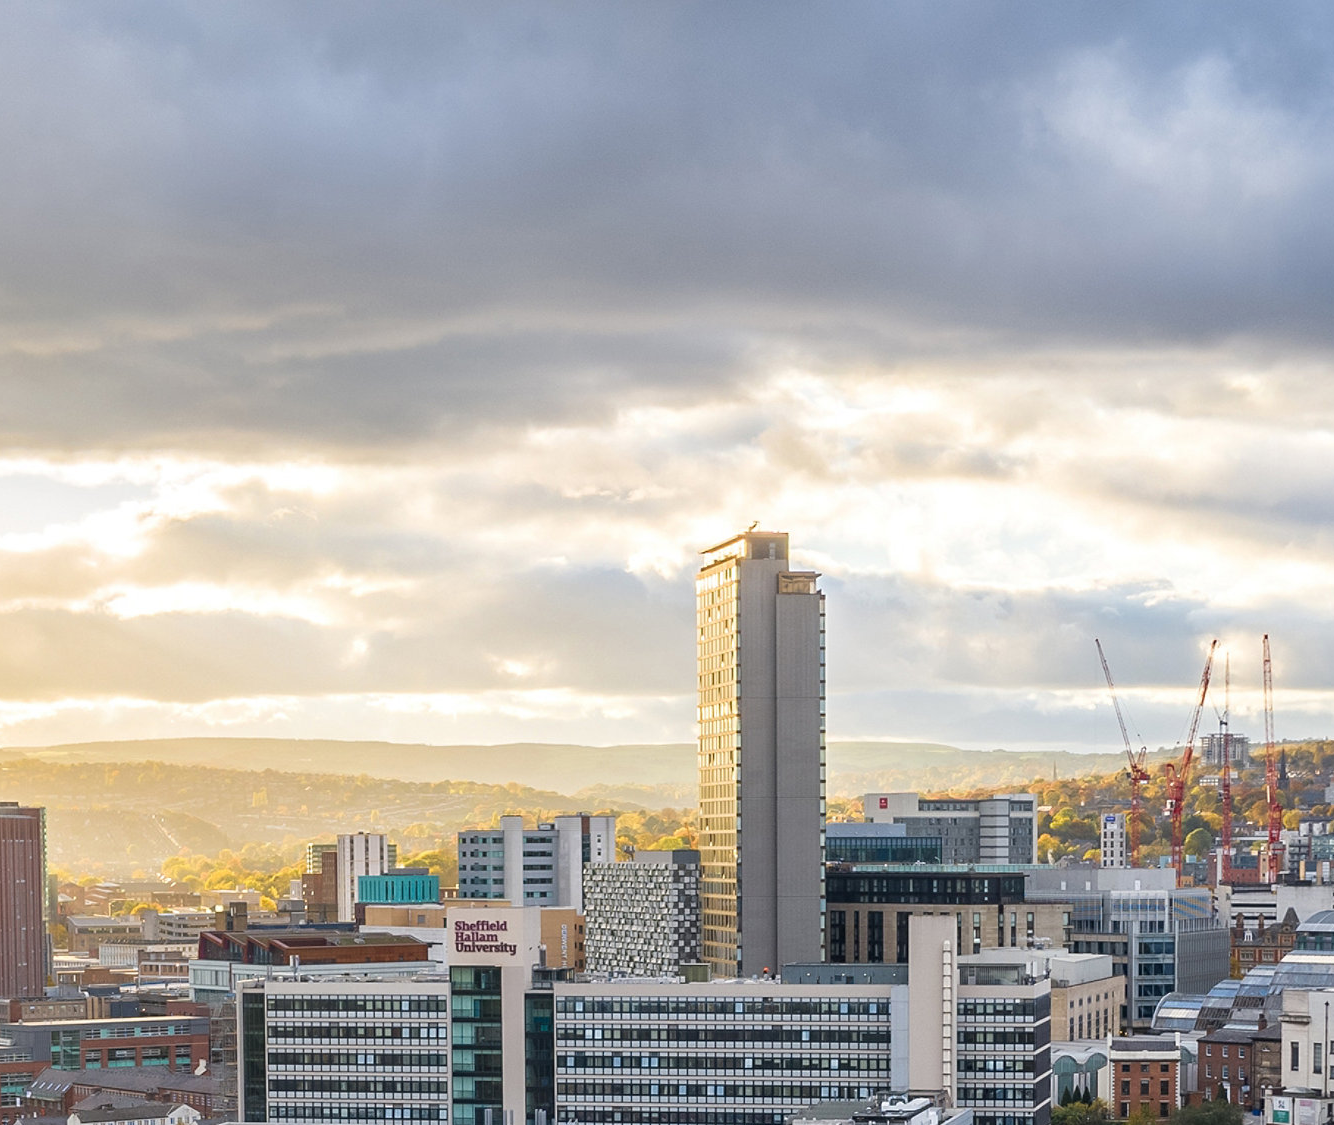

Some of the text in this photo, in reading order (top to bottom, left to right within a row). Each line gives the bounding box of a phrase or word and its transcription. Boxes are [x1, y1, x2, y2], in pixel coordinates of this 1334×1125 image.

[455, 921, 507, 931] Sheffield
[455, 932, 498, 942] Hallam
[456, 942, 517, 956] University
